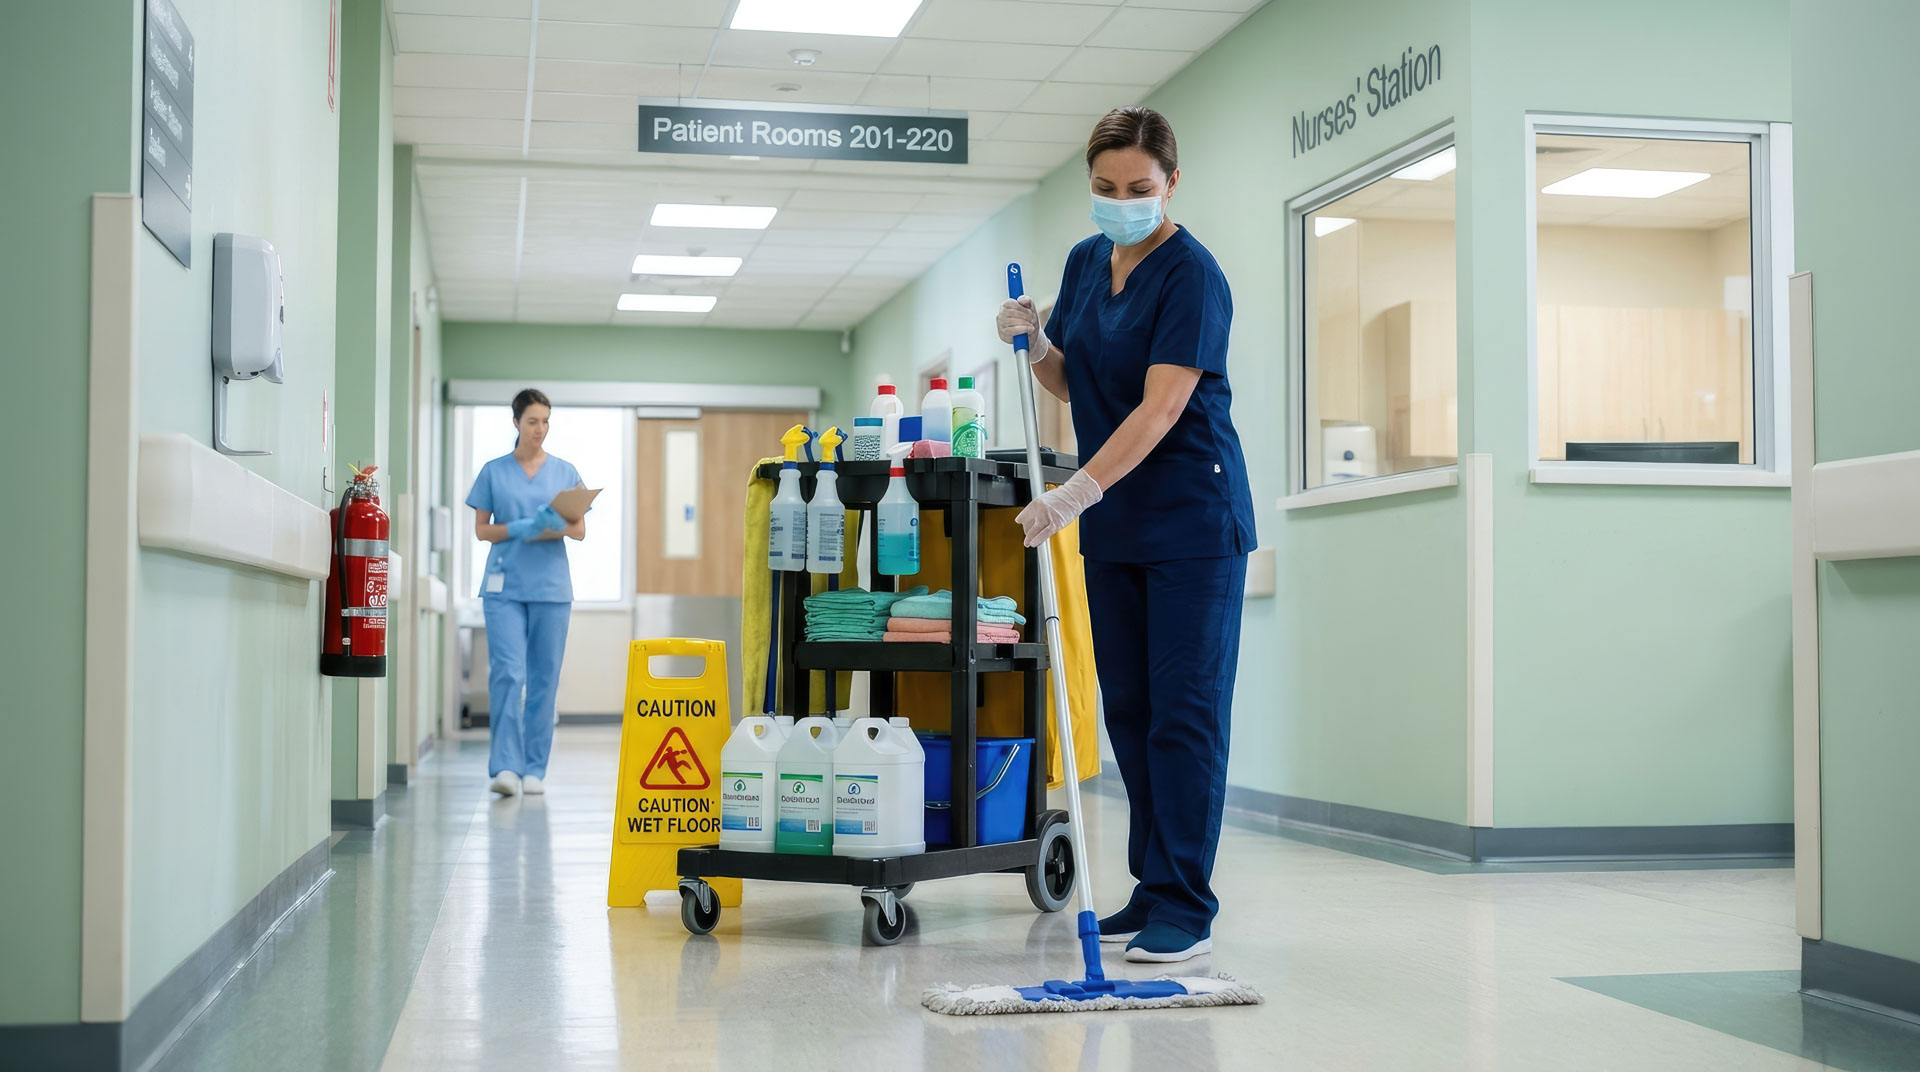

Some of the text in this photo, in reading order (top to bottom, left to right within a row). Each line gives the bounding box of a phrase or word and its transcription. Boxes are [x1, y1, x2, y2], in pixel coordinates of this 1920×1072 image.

[1292, 44, 1441, 159] Nurses' Station
[653, 117, 954, 152] Patient Rooms 201-220
[636, 699, 716, 718] CAUTION
[627, 817, 721, 834] WET FLOOR
